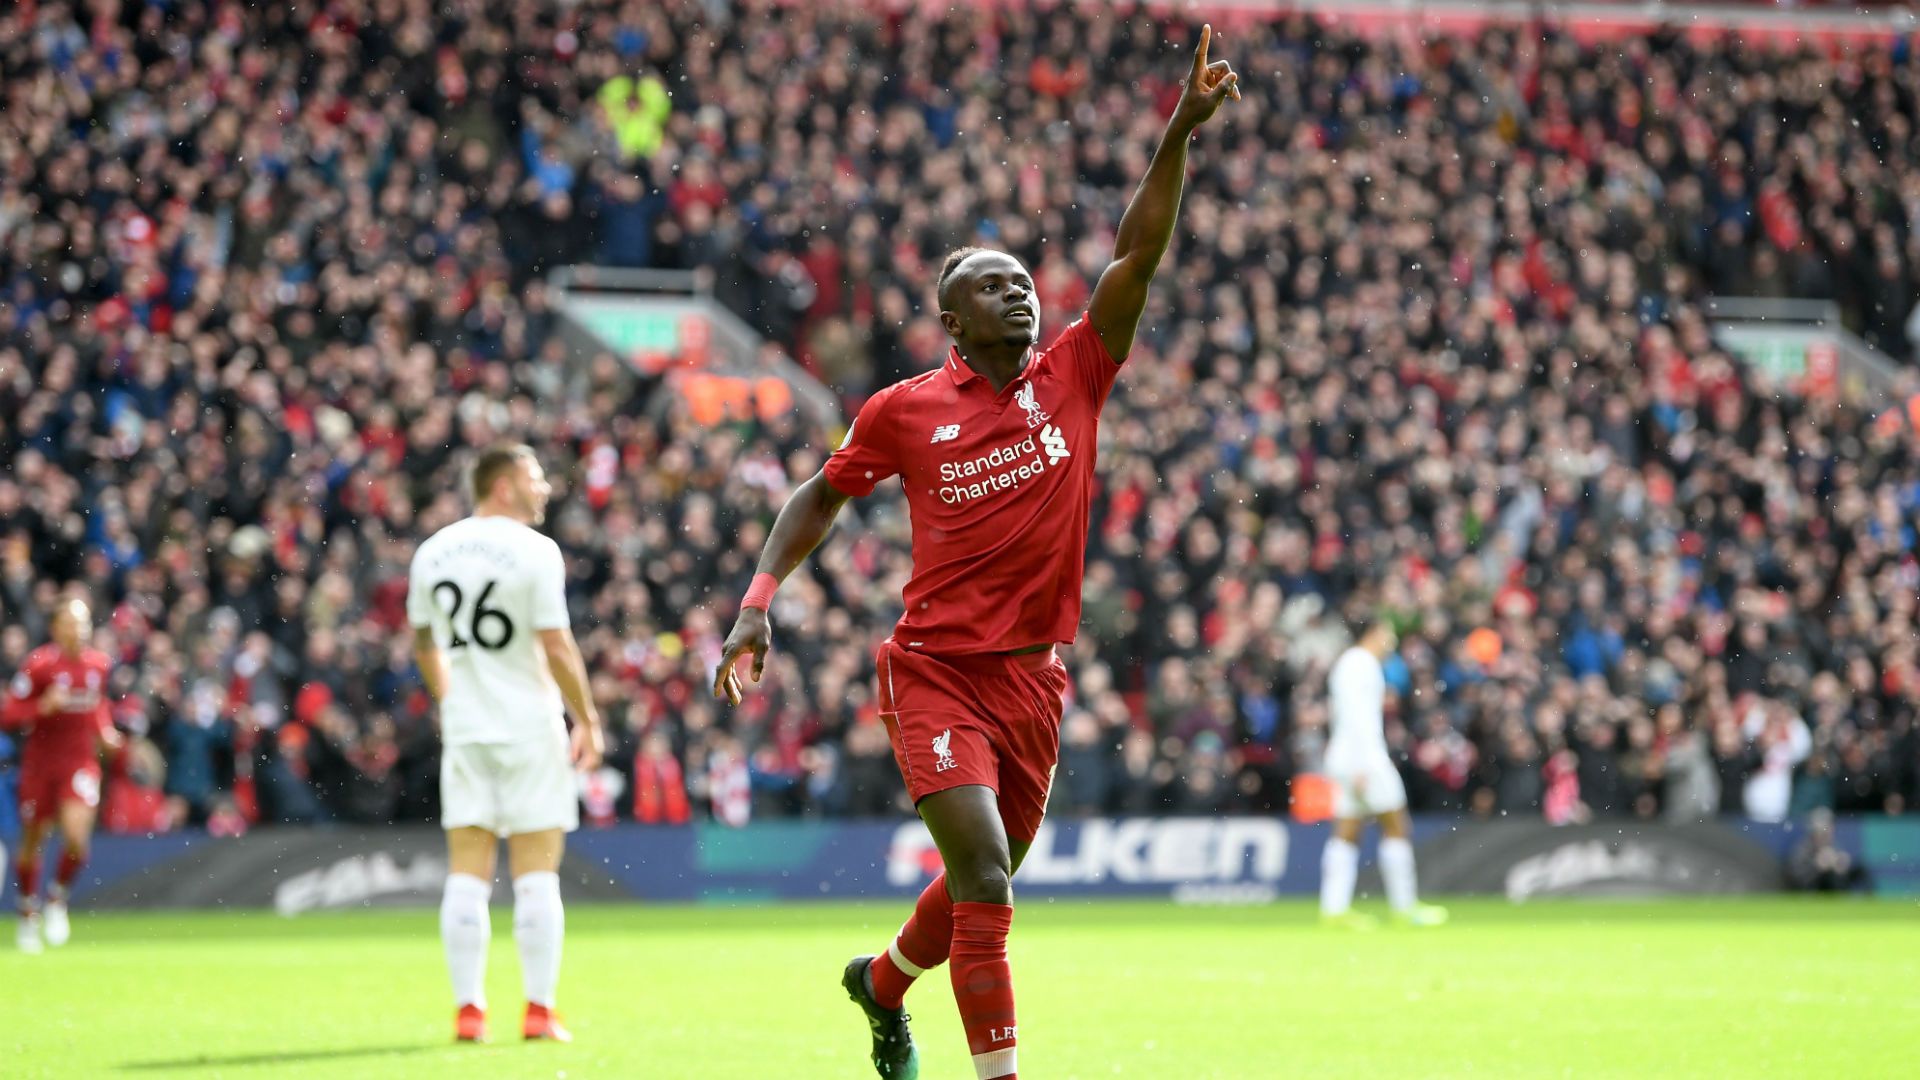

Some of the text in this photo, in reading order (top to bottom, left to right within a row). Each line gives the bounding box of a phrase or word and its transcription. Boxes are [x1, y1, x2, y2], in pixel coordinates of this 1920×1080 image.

[939, 455, 1044, 504] Chartered
[940, 434, 1036, 482] Standard
[431, 580, 514, 650] 26
[886, 817, 1290, 885] FLKEN
